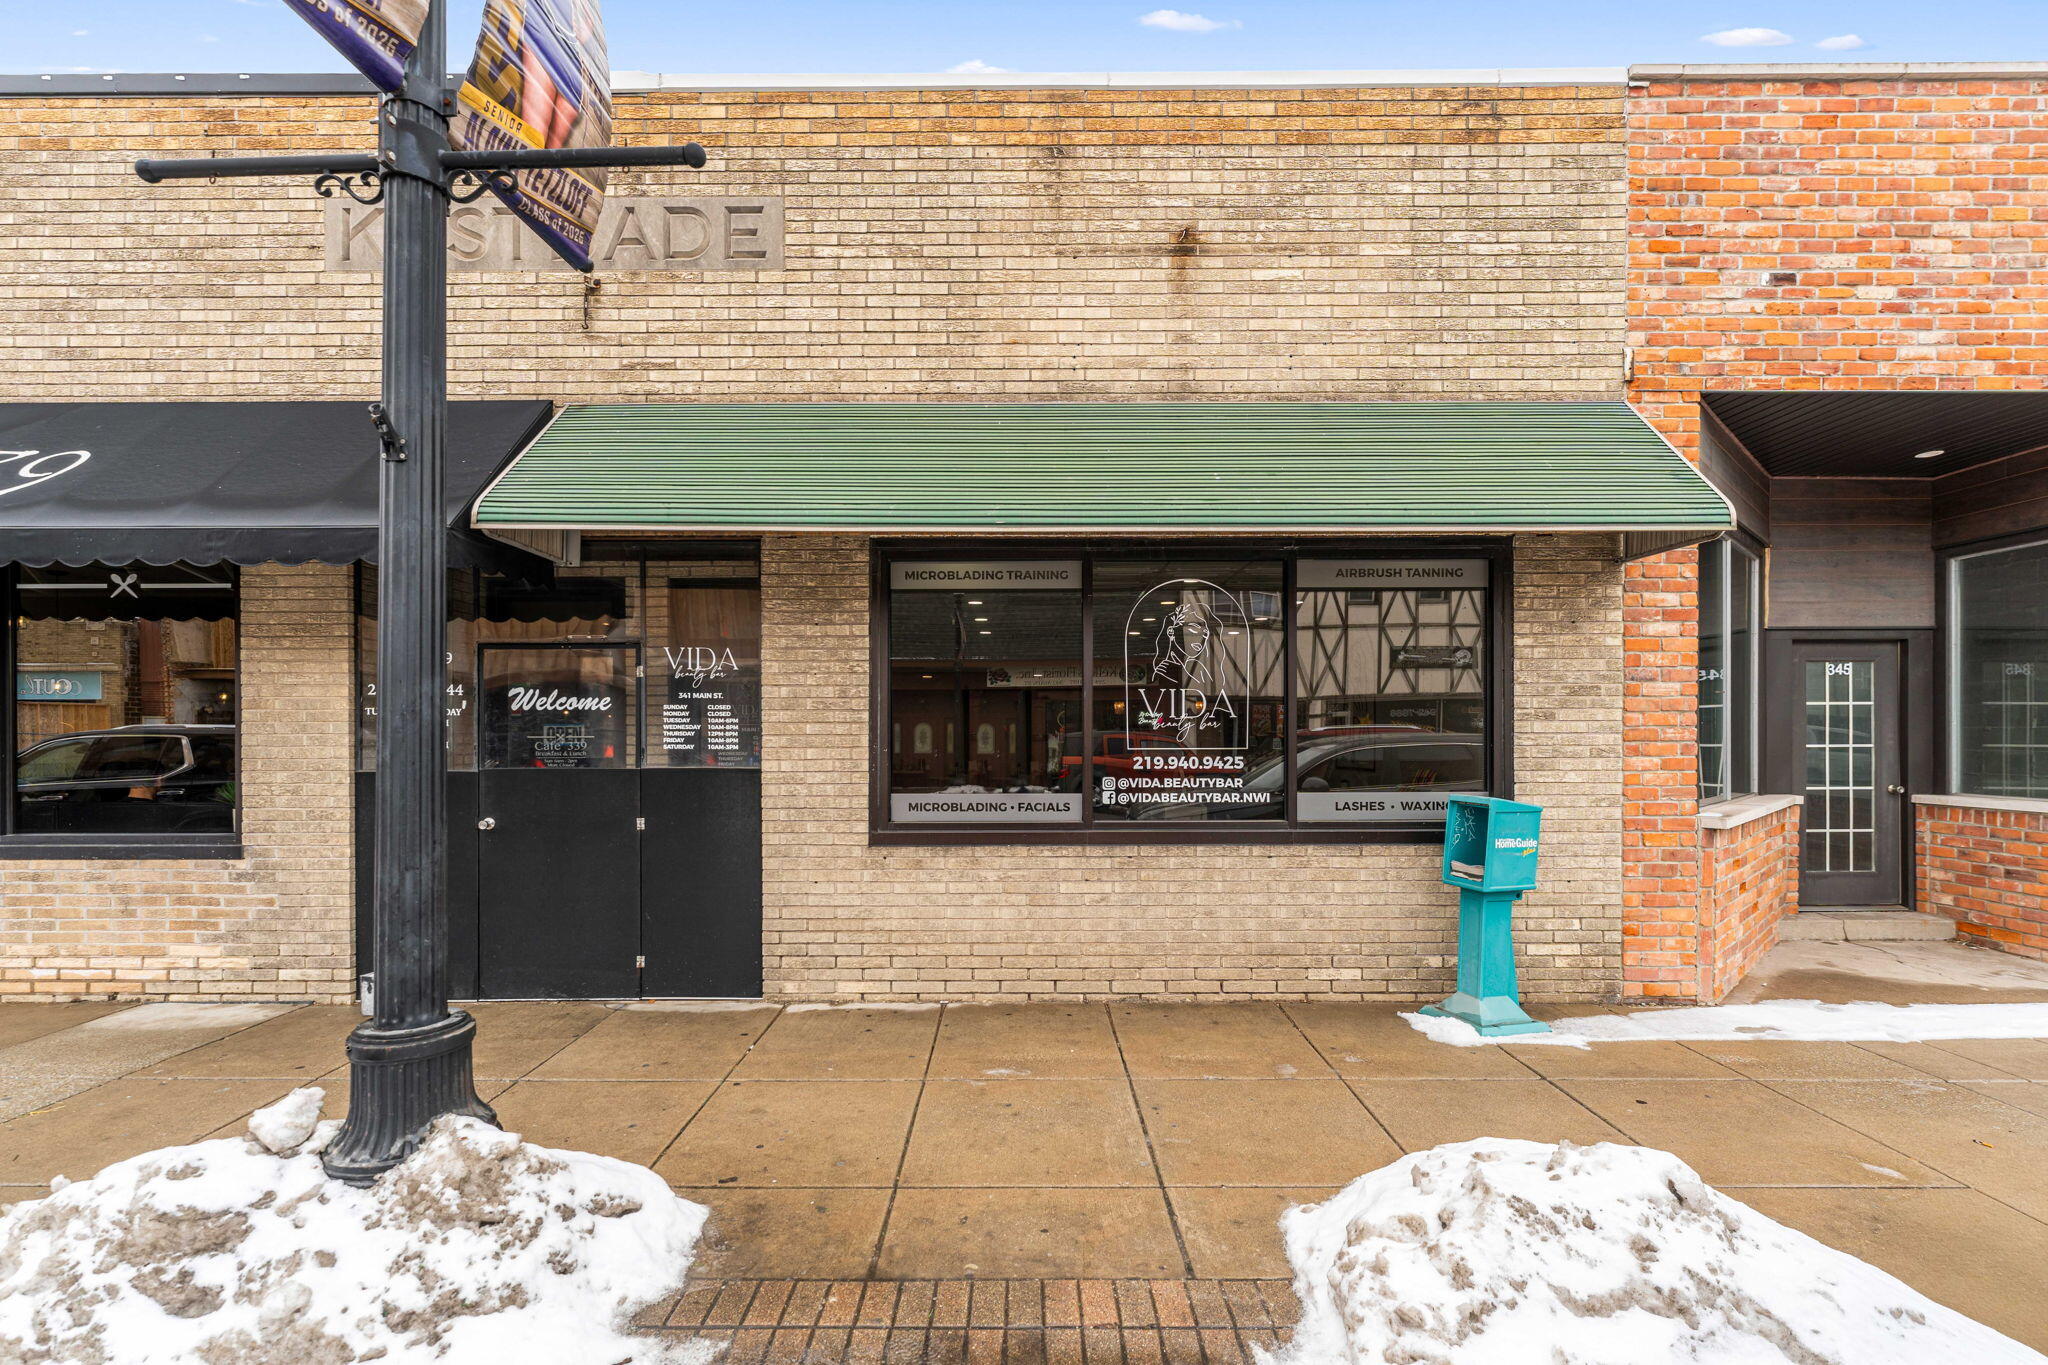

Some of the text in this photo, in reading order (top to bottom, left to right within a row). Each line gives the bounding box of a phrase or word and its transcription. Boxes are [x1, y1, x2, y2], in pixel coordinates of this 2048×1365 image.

[334, 6, 353, 28] of
[356, 16, 400, 58] 2026
[483, 100, 523, 133] SENIOR
[518, 197, 551, 226] CLASS
[552, 217, 562, 232] of
[341, 205, 767, 261] KSTADE
[904, 570, 1070, 581] MICROBLADING TRAINING
[1335, 567, 1464, 578] AIRBRUSH TANNING
[663, 646, 739, 671] VIDA
[674, 664, 727, 689] beauty bar
[1827, 663, 1851, 676] 345
[508, 687, 612, 711] Welcome
[1138, 688, 1237, 719] VIDA
[1153, 713, 1221, 742] beauty bar
[568, 742, 587, 751] 339
[1132, 756, 1244, 770] 219.940.9425
[1118, 777, 1243, 790] @VIDA.BEAUTYBAR
[908, 802, 1071, 812] MICROBLADING FACIALS
[1118, 792, 1270, 804] @VIDABEAUTYBAR.NWI
[1335, 801, 1385, 811] LASHES
